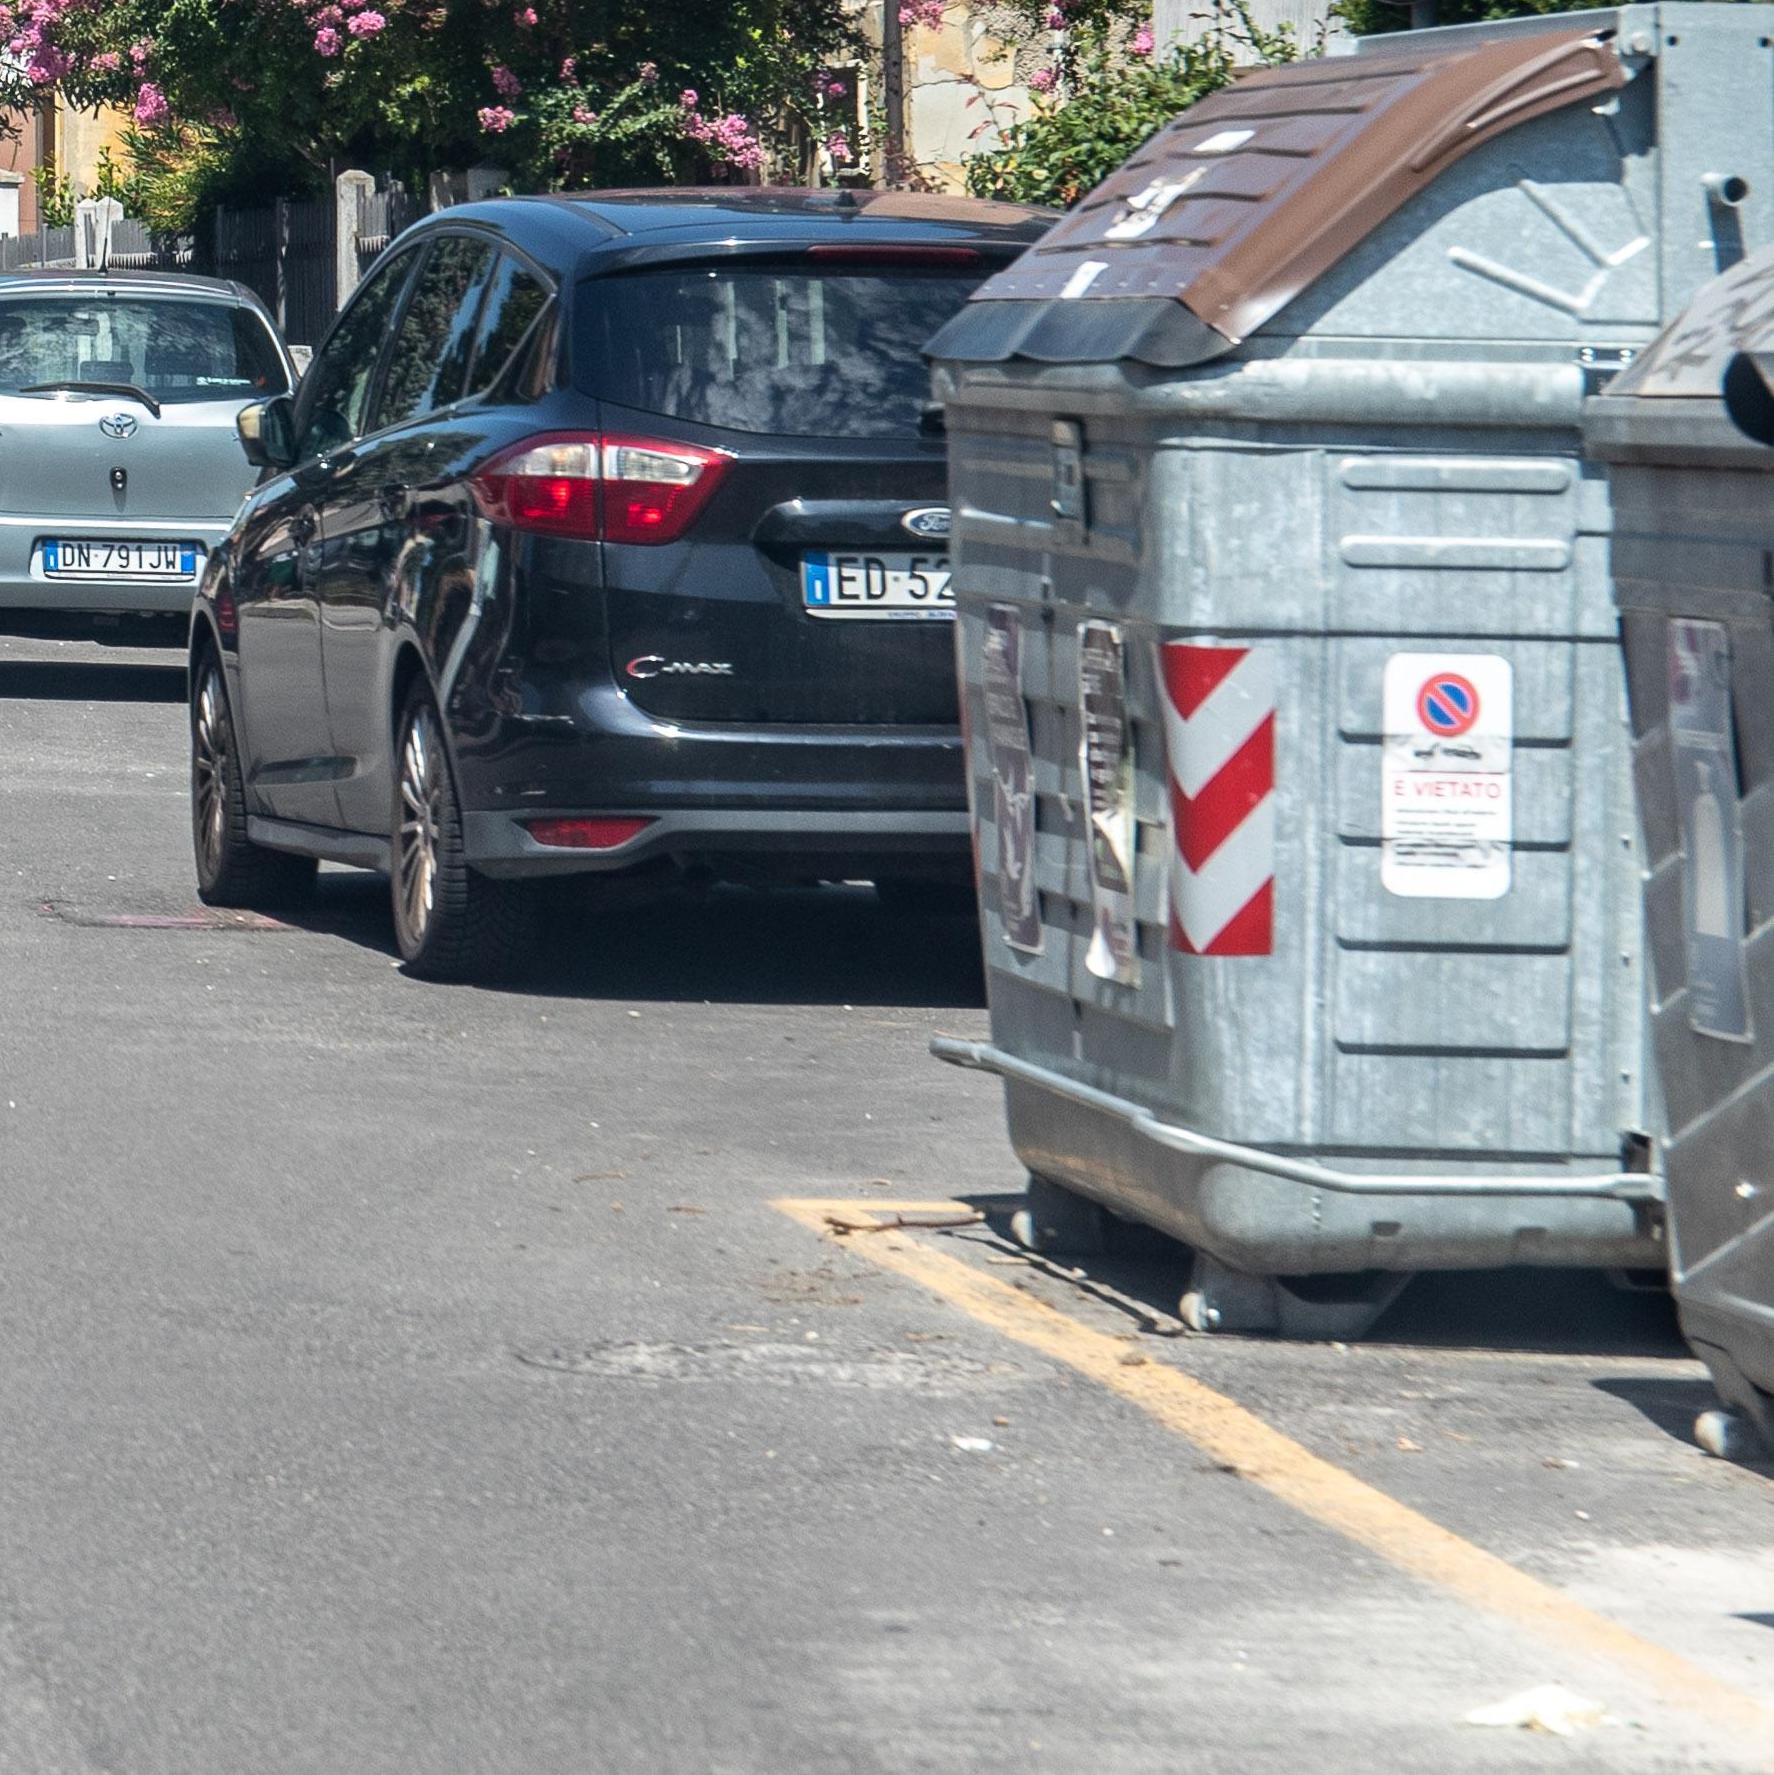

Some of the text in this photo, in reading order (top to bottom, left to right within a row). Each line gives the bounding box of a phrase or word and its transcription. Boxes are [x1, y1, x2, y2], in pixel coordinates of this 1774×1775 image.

[62, 543, 91, 567] DN
[102, 544, 177, 570] 791JW
[836, 557, 886, 600] ED
[908, 557, 955, 601] 52
[1414, 781, 1501, 799] VIETATO
